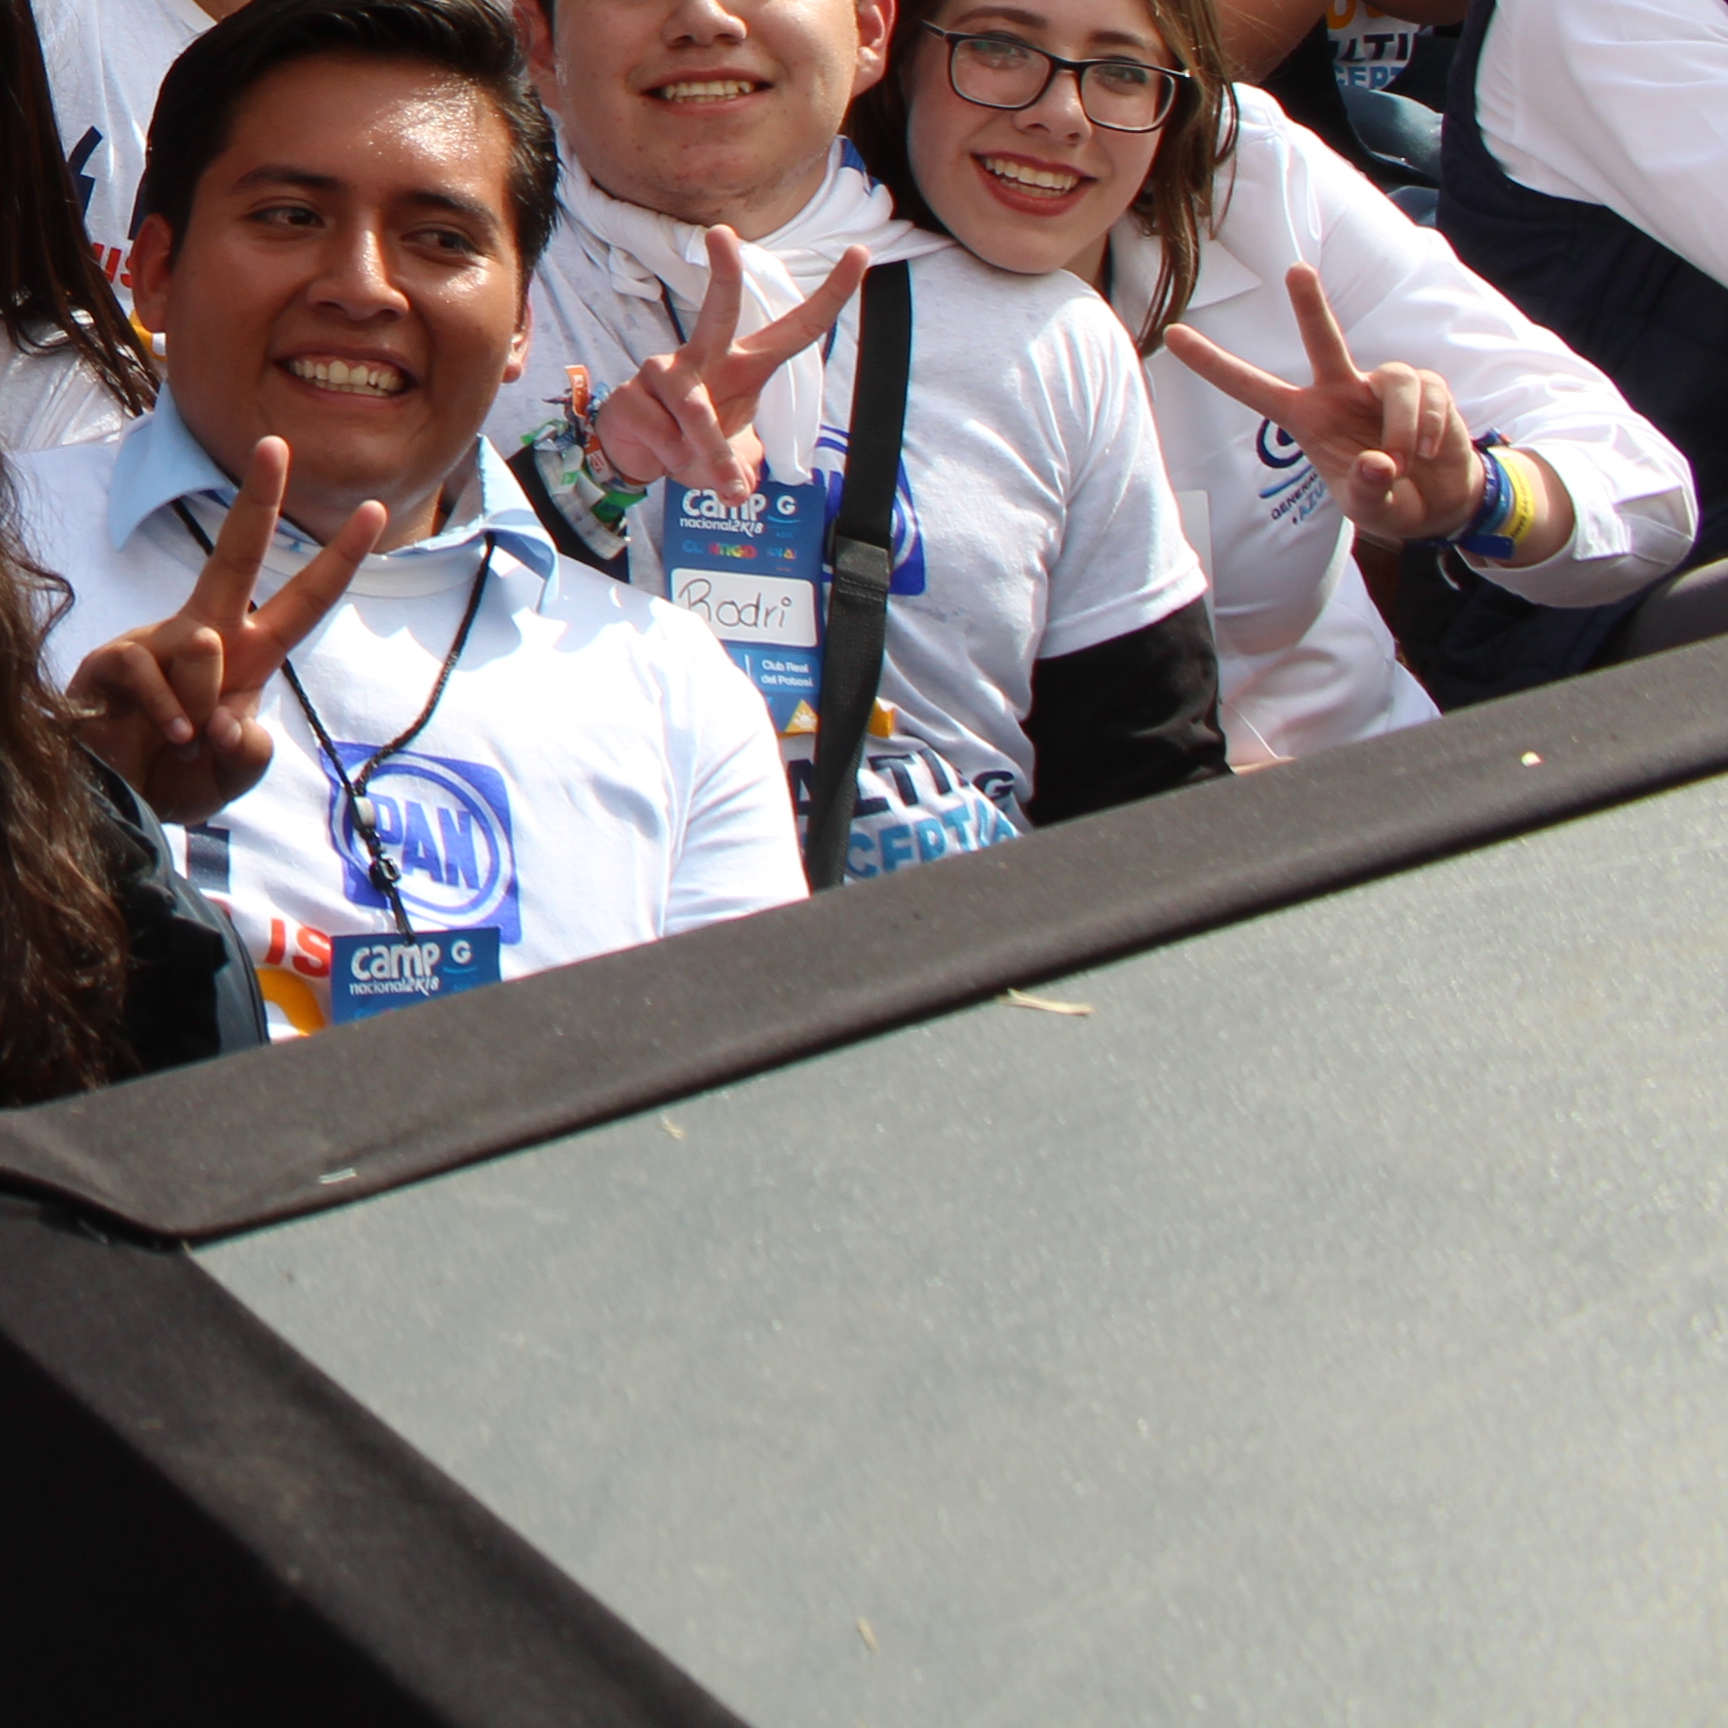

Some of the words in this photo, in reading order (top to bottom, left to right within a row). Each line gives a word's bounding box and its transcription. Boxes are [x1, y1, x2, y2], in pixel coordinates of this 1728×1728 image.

[678, 578, 792, 628] Rodri
[264, 918, 332, 978] IS
[350, 942, 441, 980] camp
